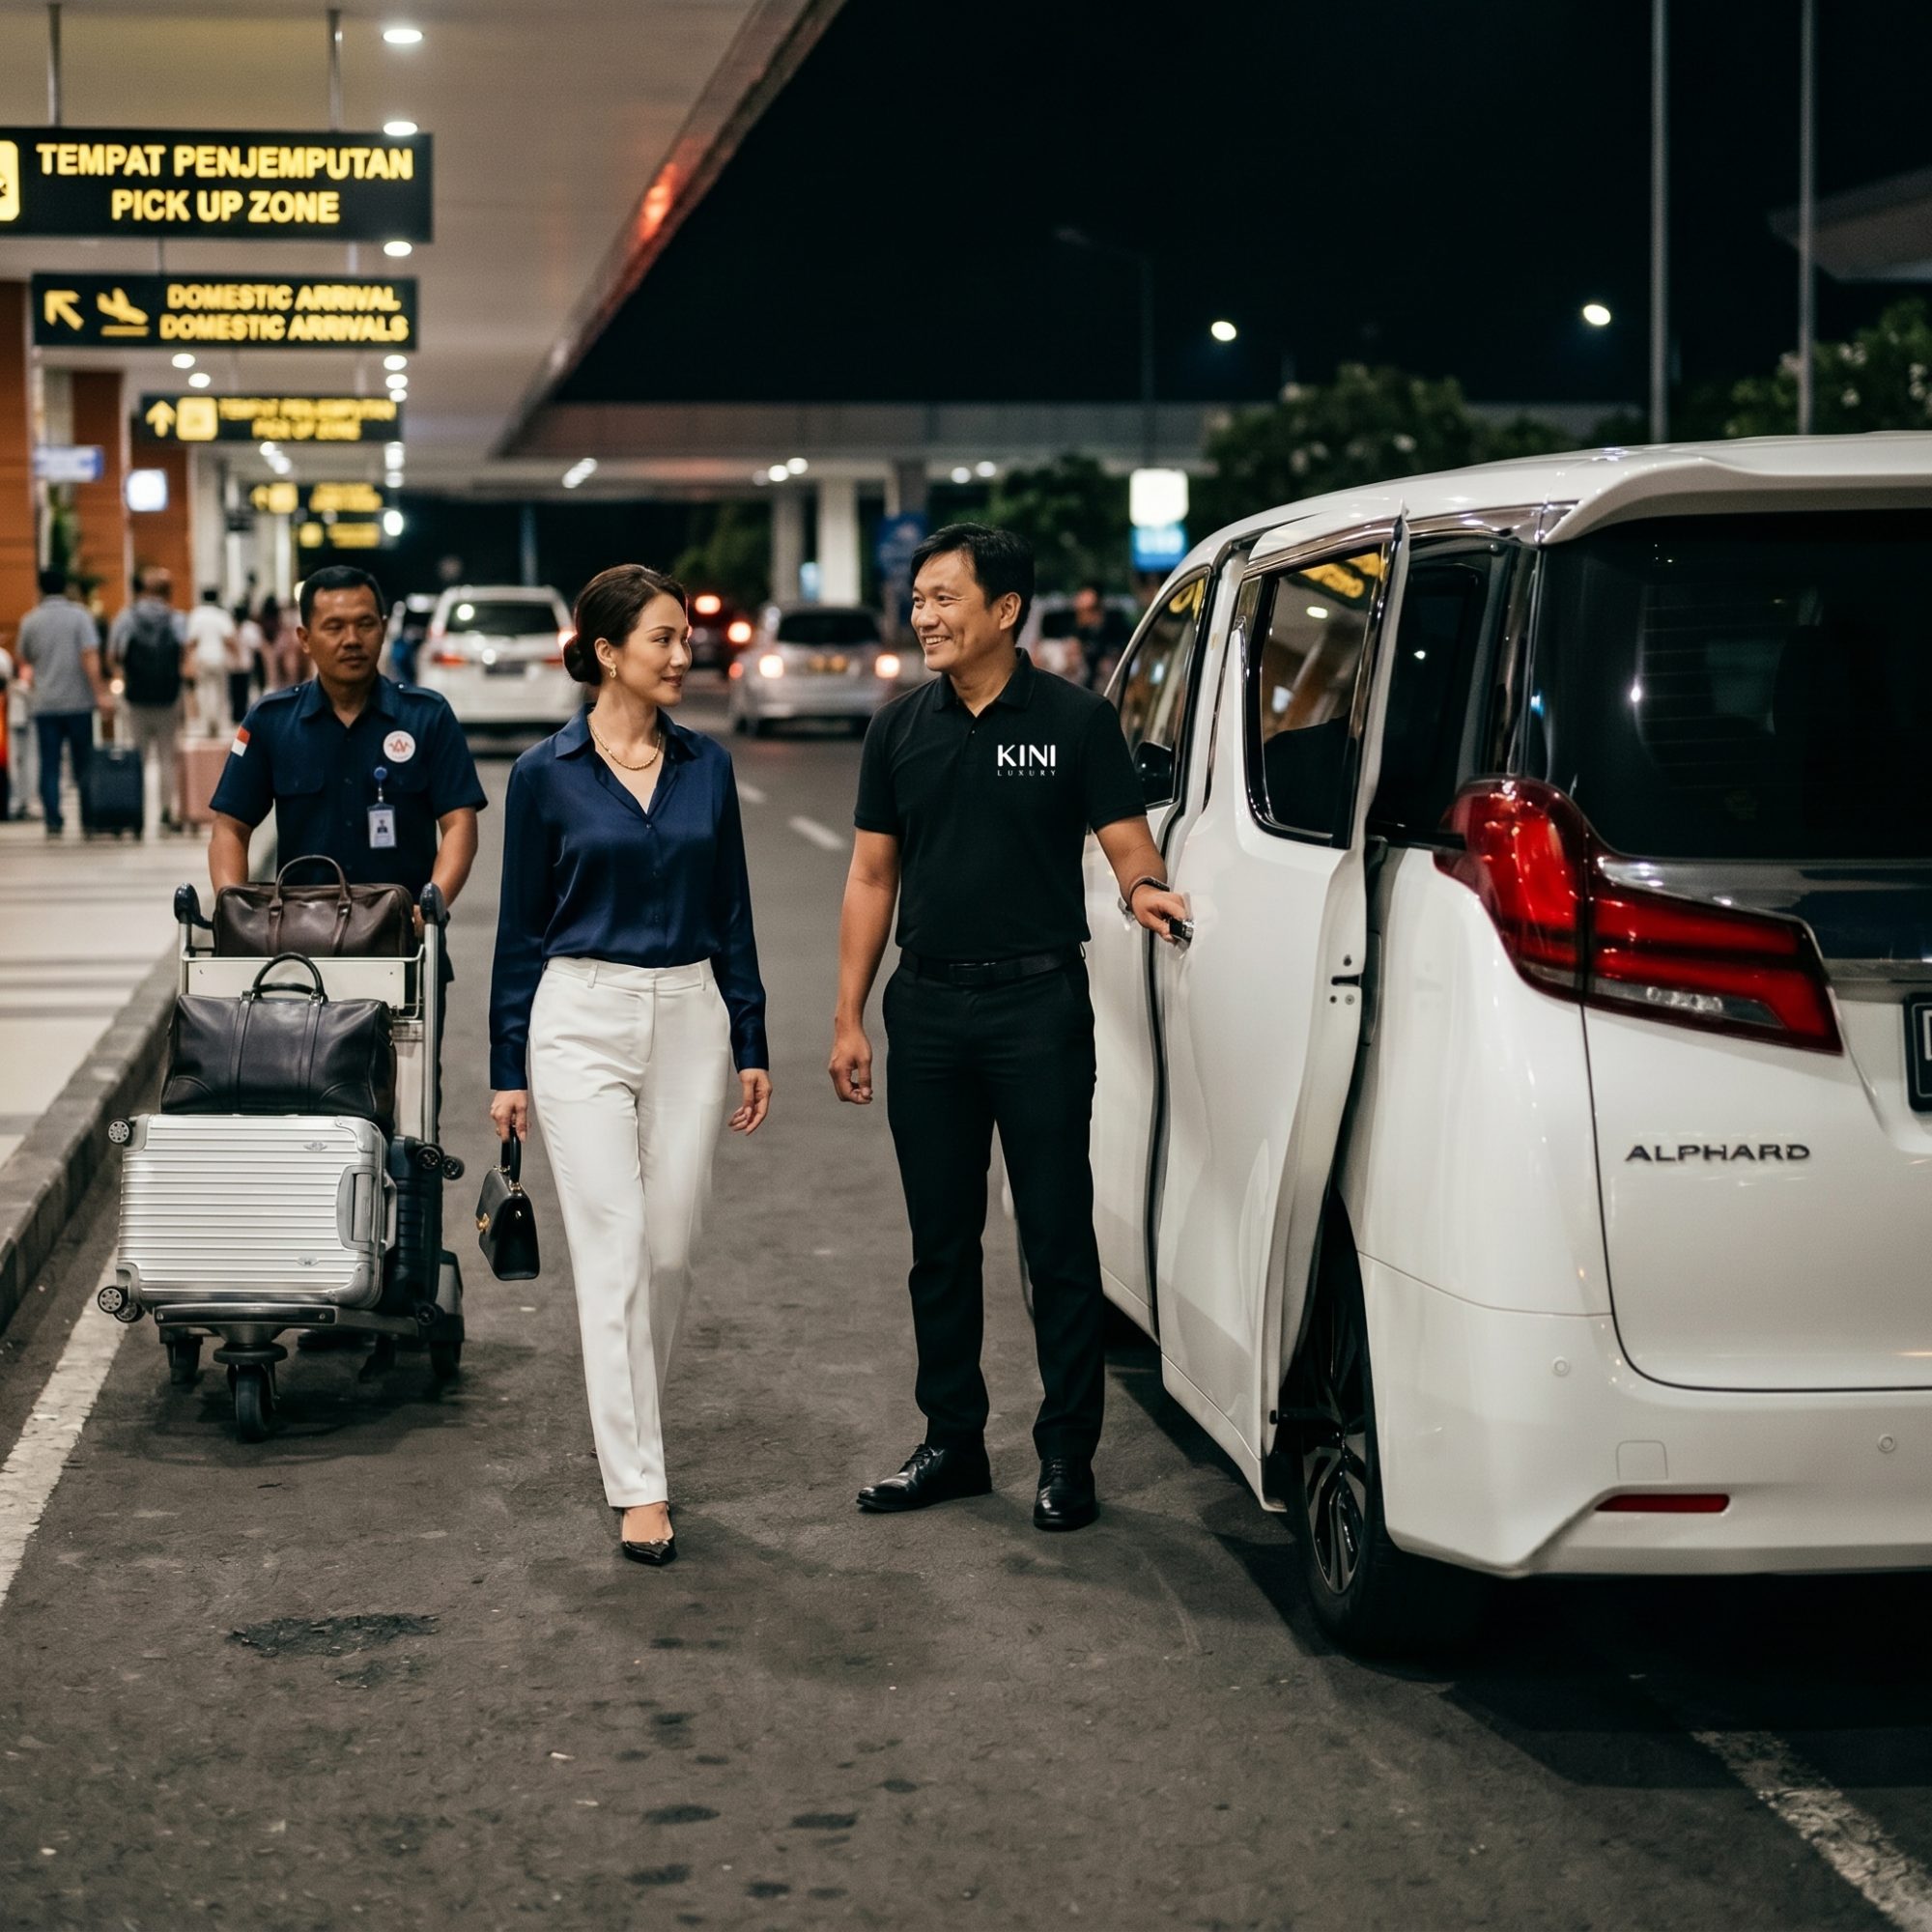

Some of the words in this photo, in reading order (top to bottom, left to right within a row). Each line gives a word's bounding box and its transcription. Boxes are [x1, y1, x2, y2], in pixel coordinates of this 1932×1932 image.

[36, 144, 166, 177] TEMPAT
[174, 145, 413, 180] PENJEMPUTAN
[111, 189, 190, 221] PICK
[196, 190, 242, 222] UP
[247, 191, 340, 223] ZONE
[167, 283, 293, 310] DOMESTIC
[295, 285, 402, 311] ARRIVAL
[159, 314, 286, 340] DOMESTIC
[288, 315, 409, 341] ARRIVALS
[997, 744, 1056, 767] KINI
[1625, 1144, 1810, 1161] ALPHARD
